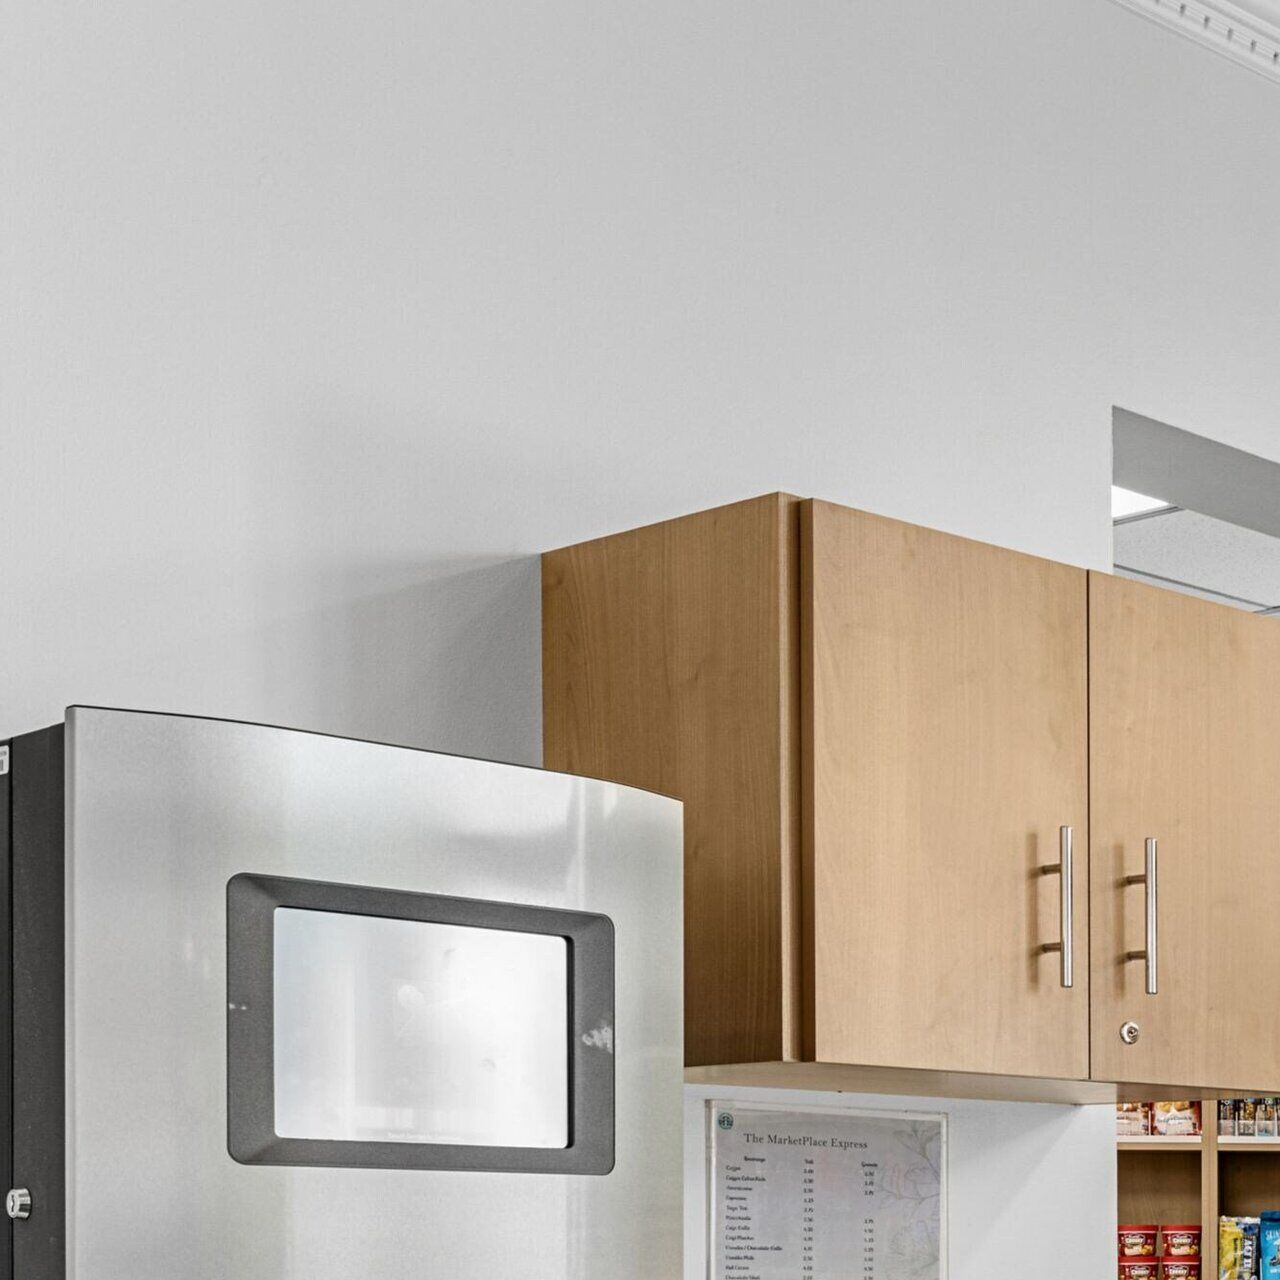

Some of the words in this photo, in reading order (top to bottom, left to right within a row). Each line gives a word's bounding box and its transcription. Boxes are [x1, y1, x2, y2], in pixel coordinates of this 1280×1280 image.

[743, 1132, 764, 1144] The
[767, 1134, 828, 1147] MarketPlace
[830, 1137, 868, 1150] Express
